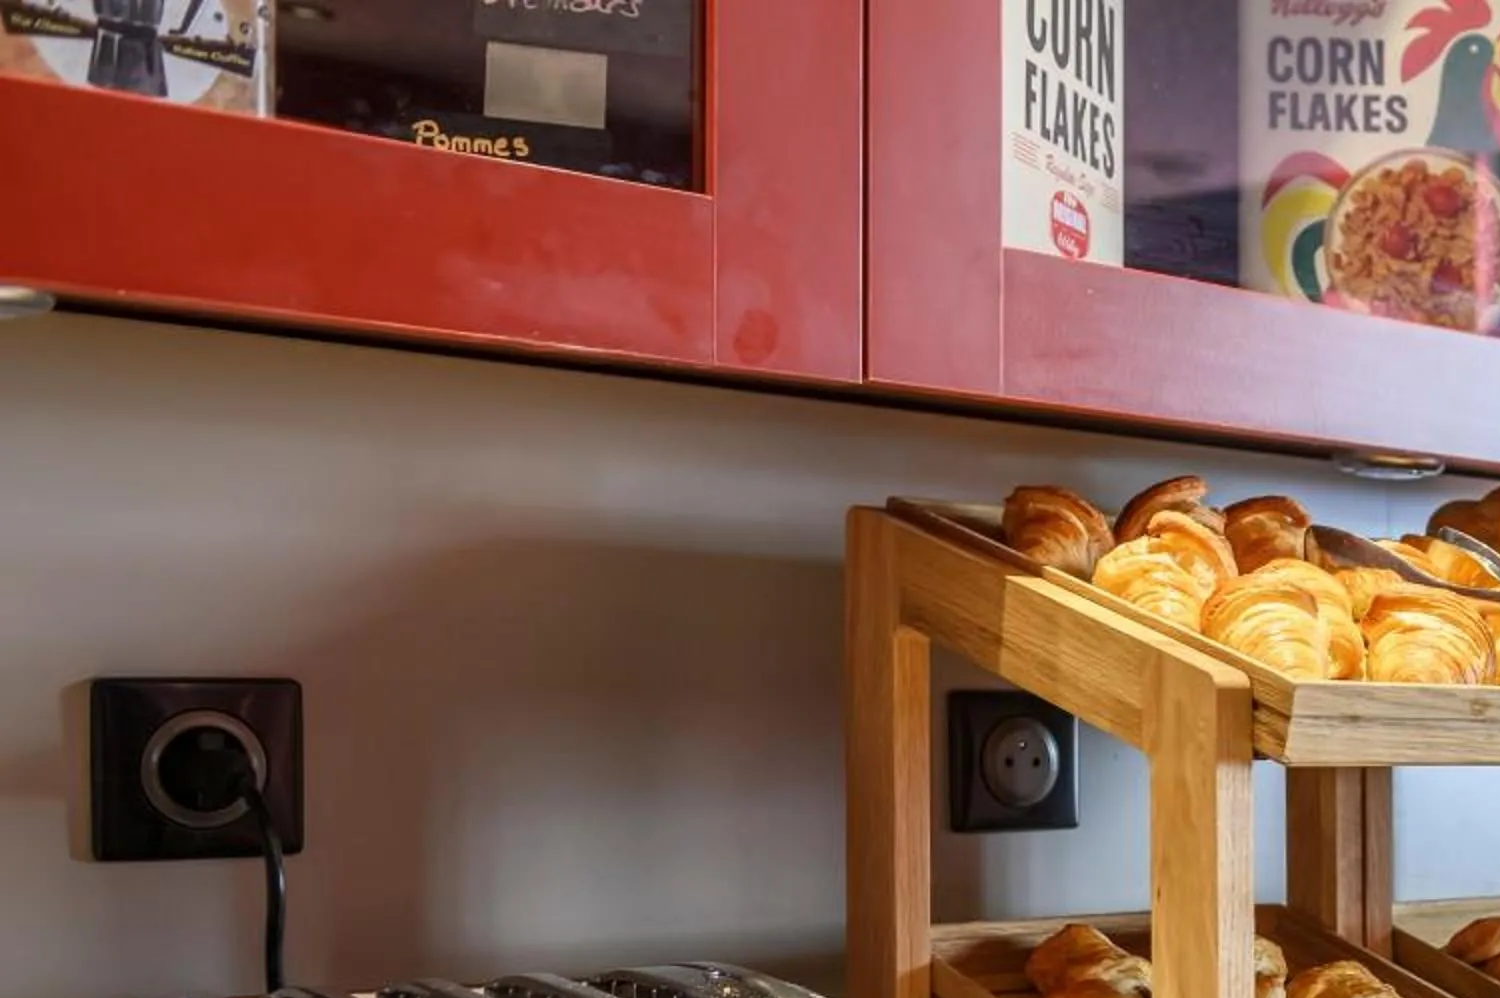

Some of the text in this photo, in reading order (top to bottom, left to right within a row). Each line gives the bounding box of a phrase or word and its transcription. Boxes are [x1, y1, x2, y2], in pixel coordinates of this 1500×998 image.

[1025, 0, 1115, 104] CORN
[1267, 35, 1386, 87] CORN
[412, 119, 529, 157] Pommes
[1024, 57, 1115, 179] FLAKES
[1268, 90, 1408, 134] FLAKES
